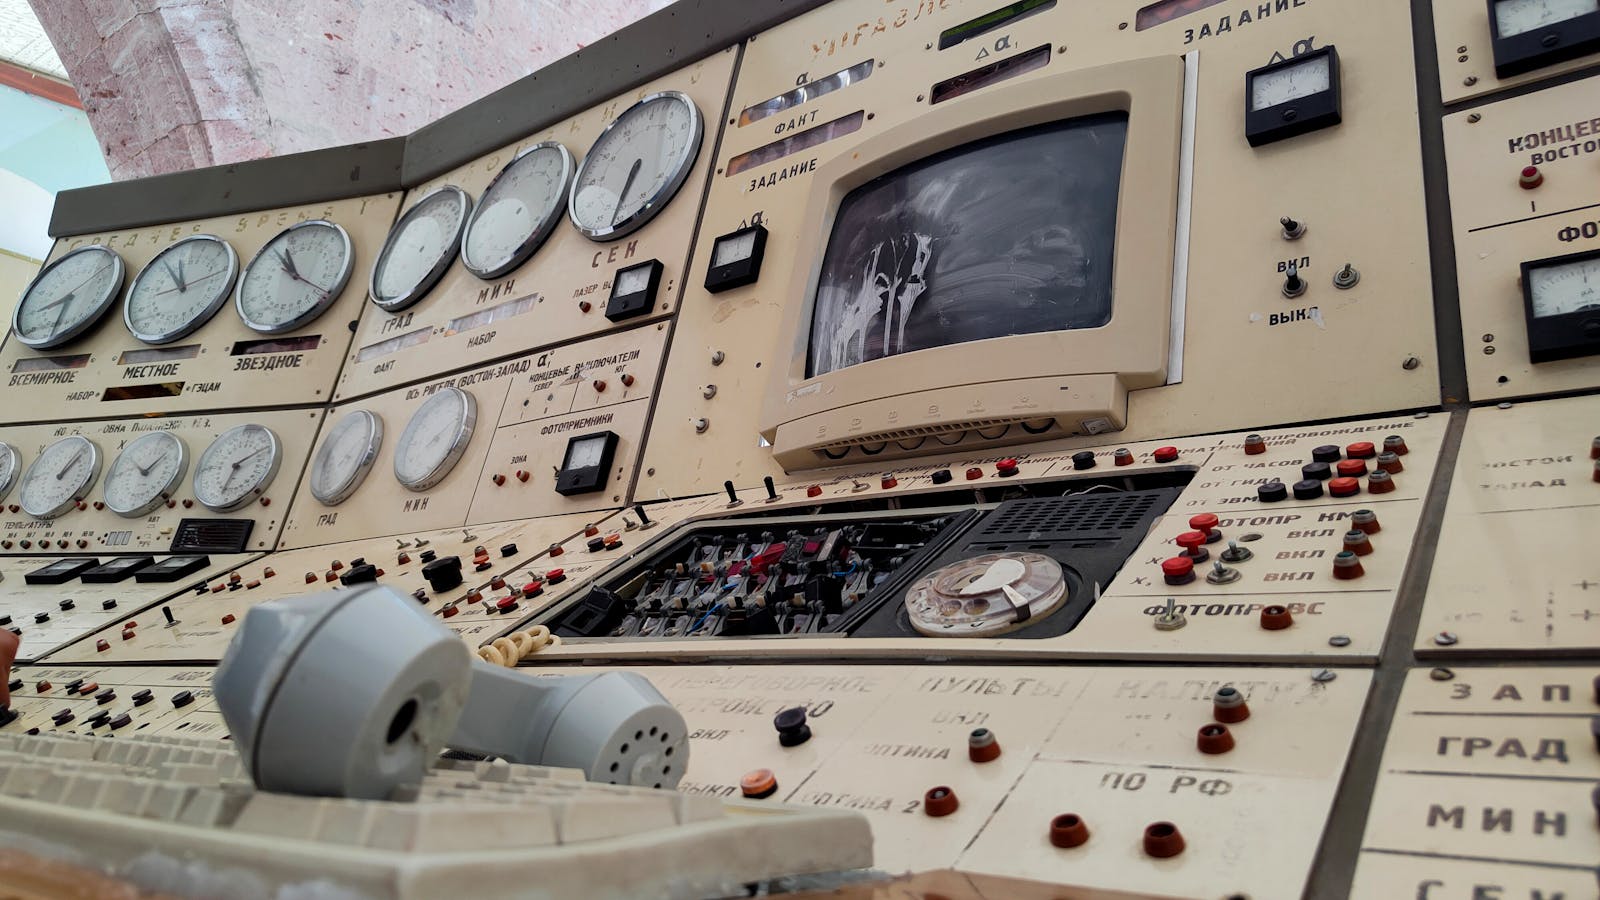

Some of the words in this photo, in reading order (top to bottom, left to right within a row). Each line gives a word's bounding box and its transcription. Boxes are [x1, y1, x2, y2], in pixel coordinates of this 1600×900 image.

[774, 110, 819, 135] ФАКТ
[749, 158, 818, 192] ЗАДАНИЕ
[1557, 221, 1600, 243] ФО
[1277, 256, 1310, 273] ВКЛ
[476, 280, 515, 304] МИН
[381, 312, 414, 334] ГРАД
[467, 331, 496, 348] НАБОР
[123, 363, 180, 380] МЕСТНОЕ
[234, 355, 303, 371] ЗВЕЗДНОЕ
[374, 360, 396, 374] ФАКТ
[8, 371, 78, 387] ВСЕМИРНОЕ
[529, 366, 571, 383] КОНЦЕВЫЕ
[66, 392, 94, 401] НАБОР
[541, 413, 614, 435] ФОТОПРИЕМНИКИ
[1260, 421, 1415, 442] ОПРОВОЖДЕНИЕ
[1244, 459, 1304, 469] ЧАСОВ
[1481, 455, 1574, 469] ОСТОК
[1200, 480, 1222, 488] ОТ
[1230, 477, 1282, 486] ГИДА
[403, 498, 428, 512] МИН
[316, 513, 337, 527] ГРАД
[1217, 514, 1302, 528] ОТОПР
[1287, 529, 1335, 539] ВКЛ
[1275, 550, 1326, 561] ВКЛ
[1263, 571, 1315, 582] ВКЛ
[1450, 683, 1570, 702] ЗАП
[1437, 736, 1569, 763] ГРАД
[1101, 771, 1147, 791] ПО
[1169, 775, 1232, 797] РФ
[902, 800, 920, 813] 2
[1426, 804, 1567, 837] МИН
